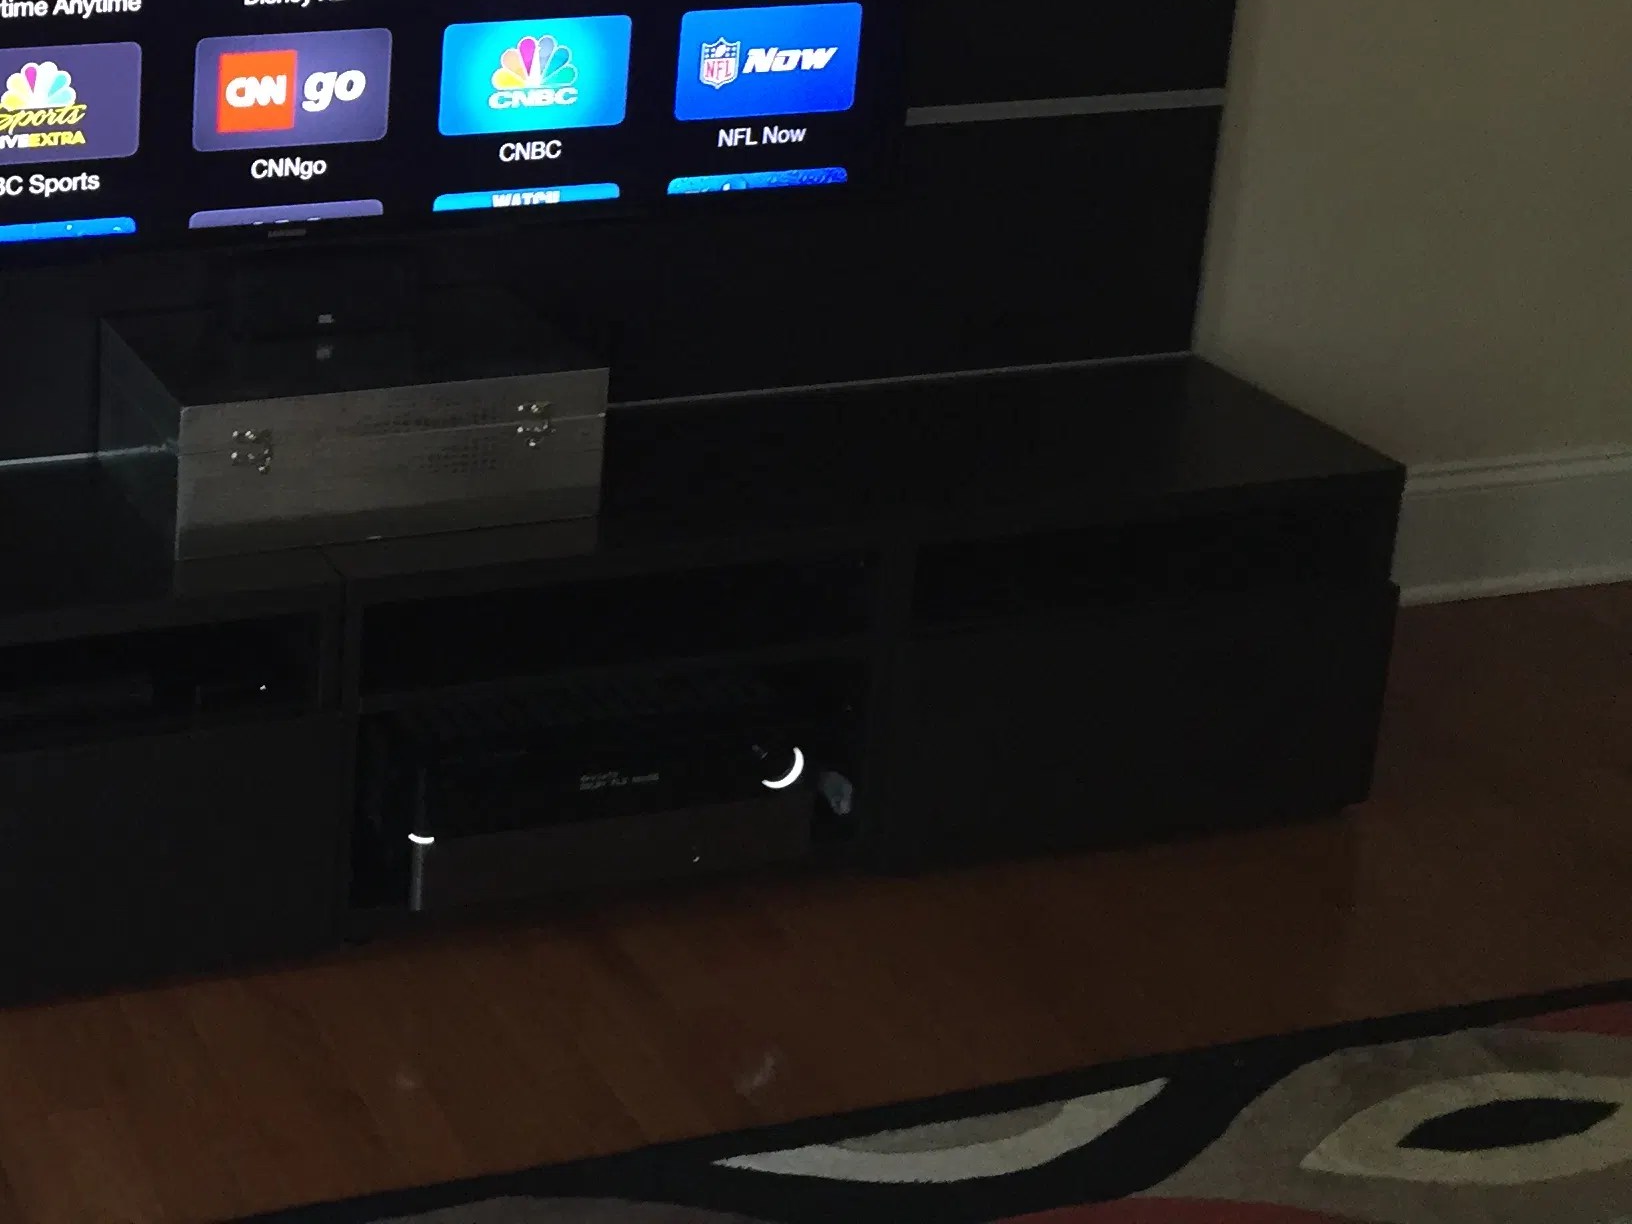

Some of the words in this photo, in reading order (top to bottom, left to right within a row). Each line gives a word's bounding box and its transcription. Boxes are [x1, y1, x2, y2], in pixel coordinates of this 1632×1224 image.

[705, 60, 732, 80] NFL
[225, 75, 287, 108] CNN
[302, 70, 366, 111] go
[488, 87, 579, 109] CNBC
[717, 127, 759, 148] NFL
[761, 125, 807, 145] Now
[498, 139, 563, 163] CNBC
[250, 156, 328, 181] CNNgo
[28, 171, 101, 198] Sports
